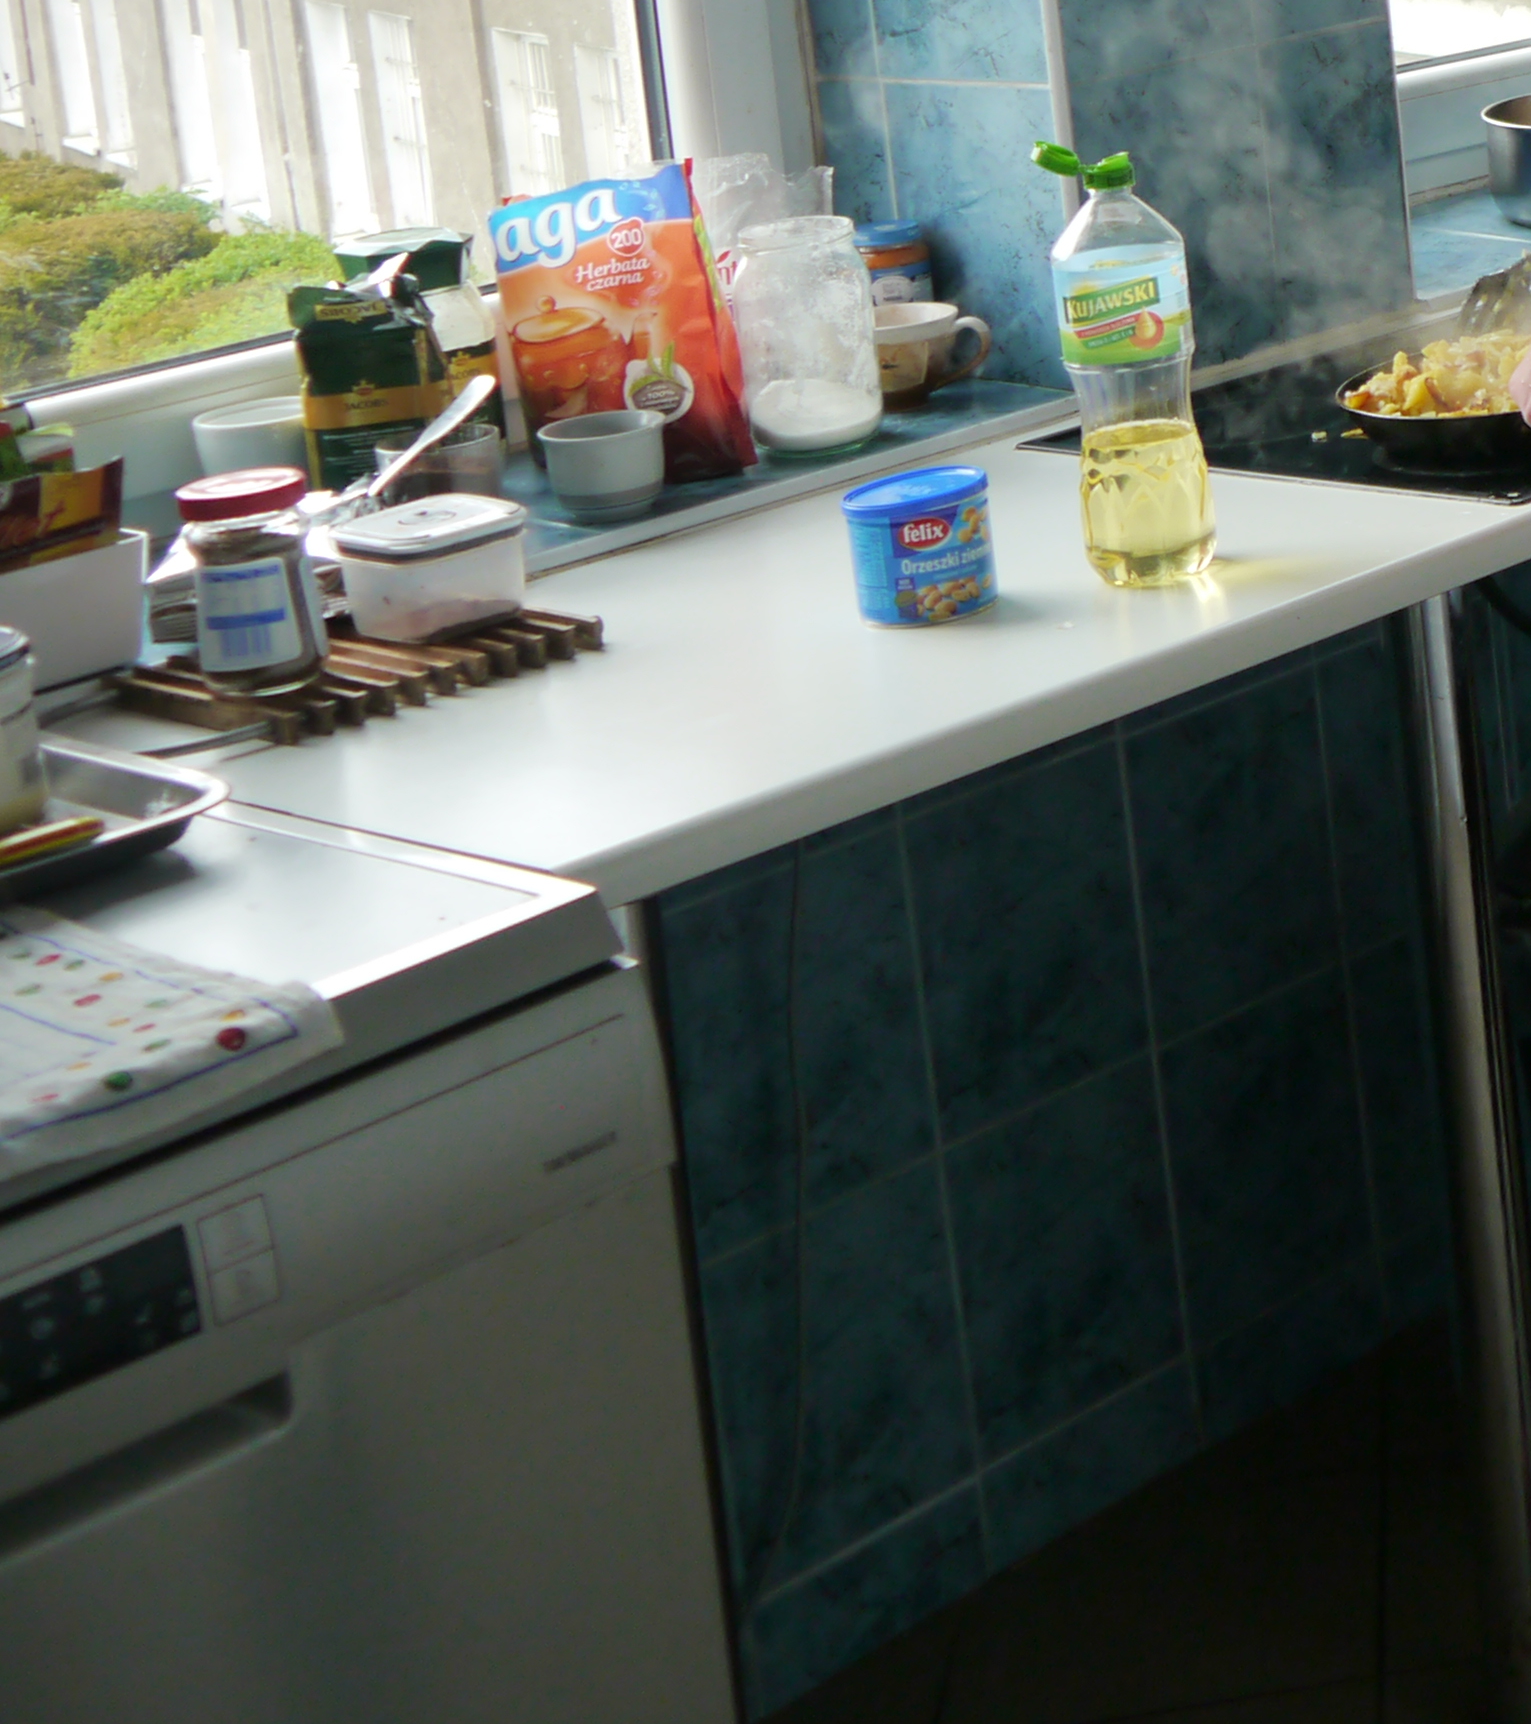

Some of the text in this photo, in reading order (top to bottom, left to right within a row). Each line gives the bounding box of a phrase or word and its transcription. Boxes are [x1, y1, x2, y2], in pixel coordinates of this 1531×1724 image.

[610, 228, 642, 249] 200
[576, 256, 651, 283] Herbata
[586, 270, 645, 291] czarna
[319, 301, 379, 317] JACOBS
[1066, 280, 1156, 320] KUJAWSKI
[344, 398, 390, 411] JACOBS
[903, 522, 944, 543] felix
[901, 551, 960, 575] Orzeszki
